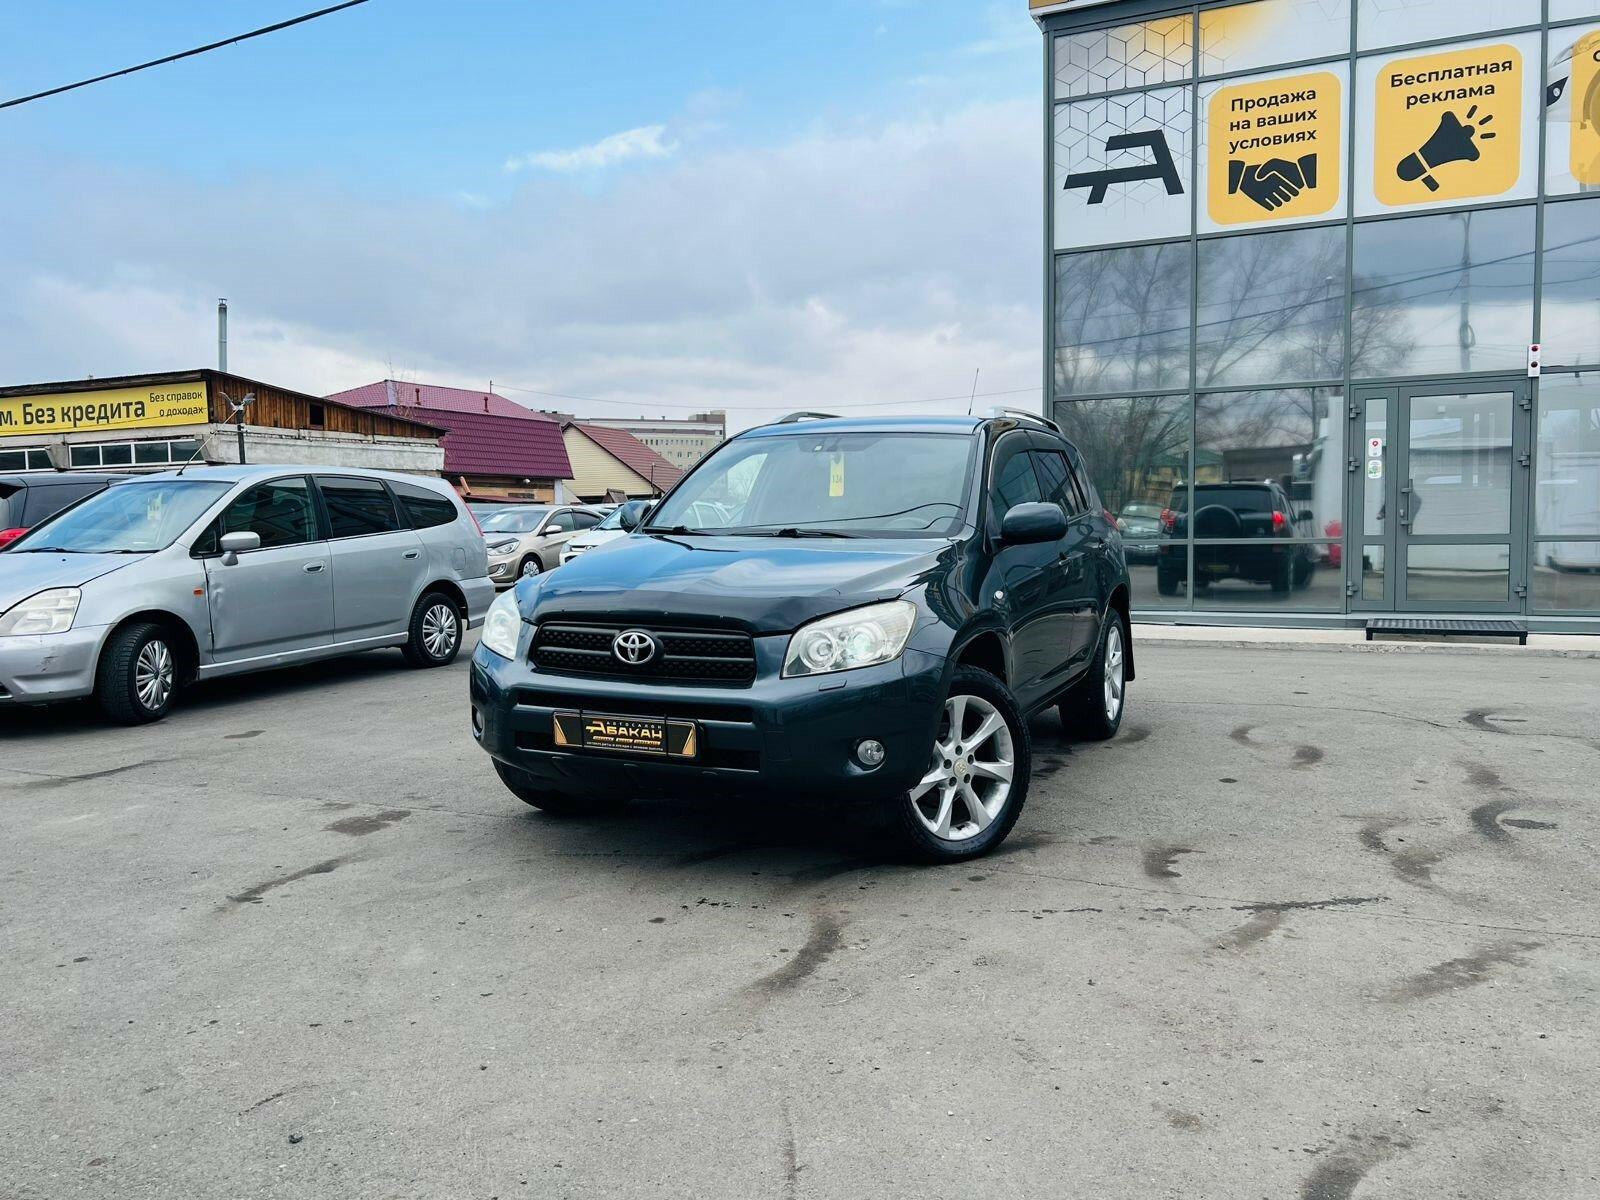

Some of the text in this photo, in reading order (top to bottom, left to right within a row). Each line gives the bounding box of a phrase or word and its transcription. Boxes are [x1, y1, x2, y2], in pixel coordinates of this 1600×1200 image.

[1390, 60, 1513, 88] Бесплатная
[1231, 90, 1316, 112] Продажа
[1406, 84, 1495, 109] реклама
[1230, 109, 1317, 131] на ваших
[1229, 130, 1317, 154] условиях
[150, 391, 203, 405] Без справок
[22, 403, 56, 425] Без
[61, 400, 146, 427] кредита
[159, 406, 204, 418] о доходах
